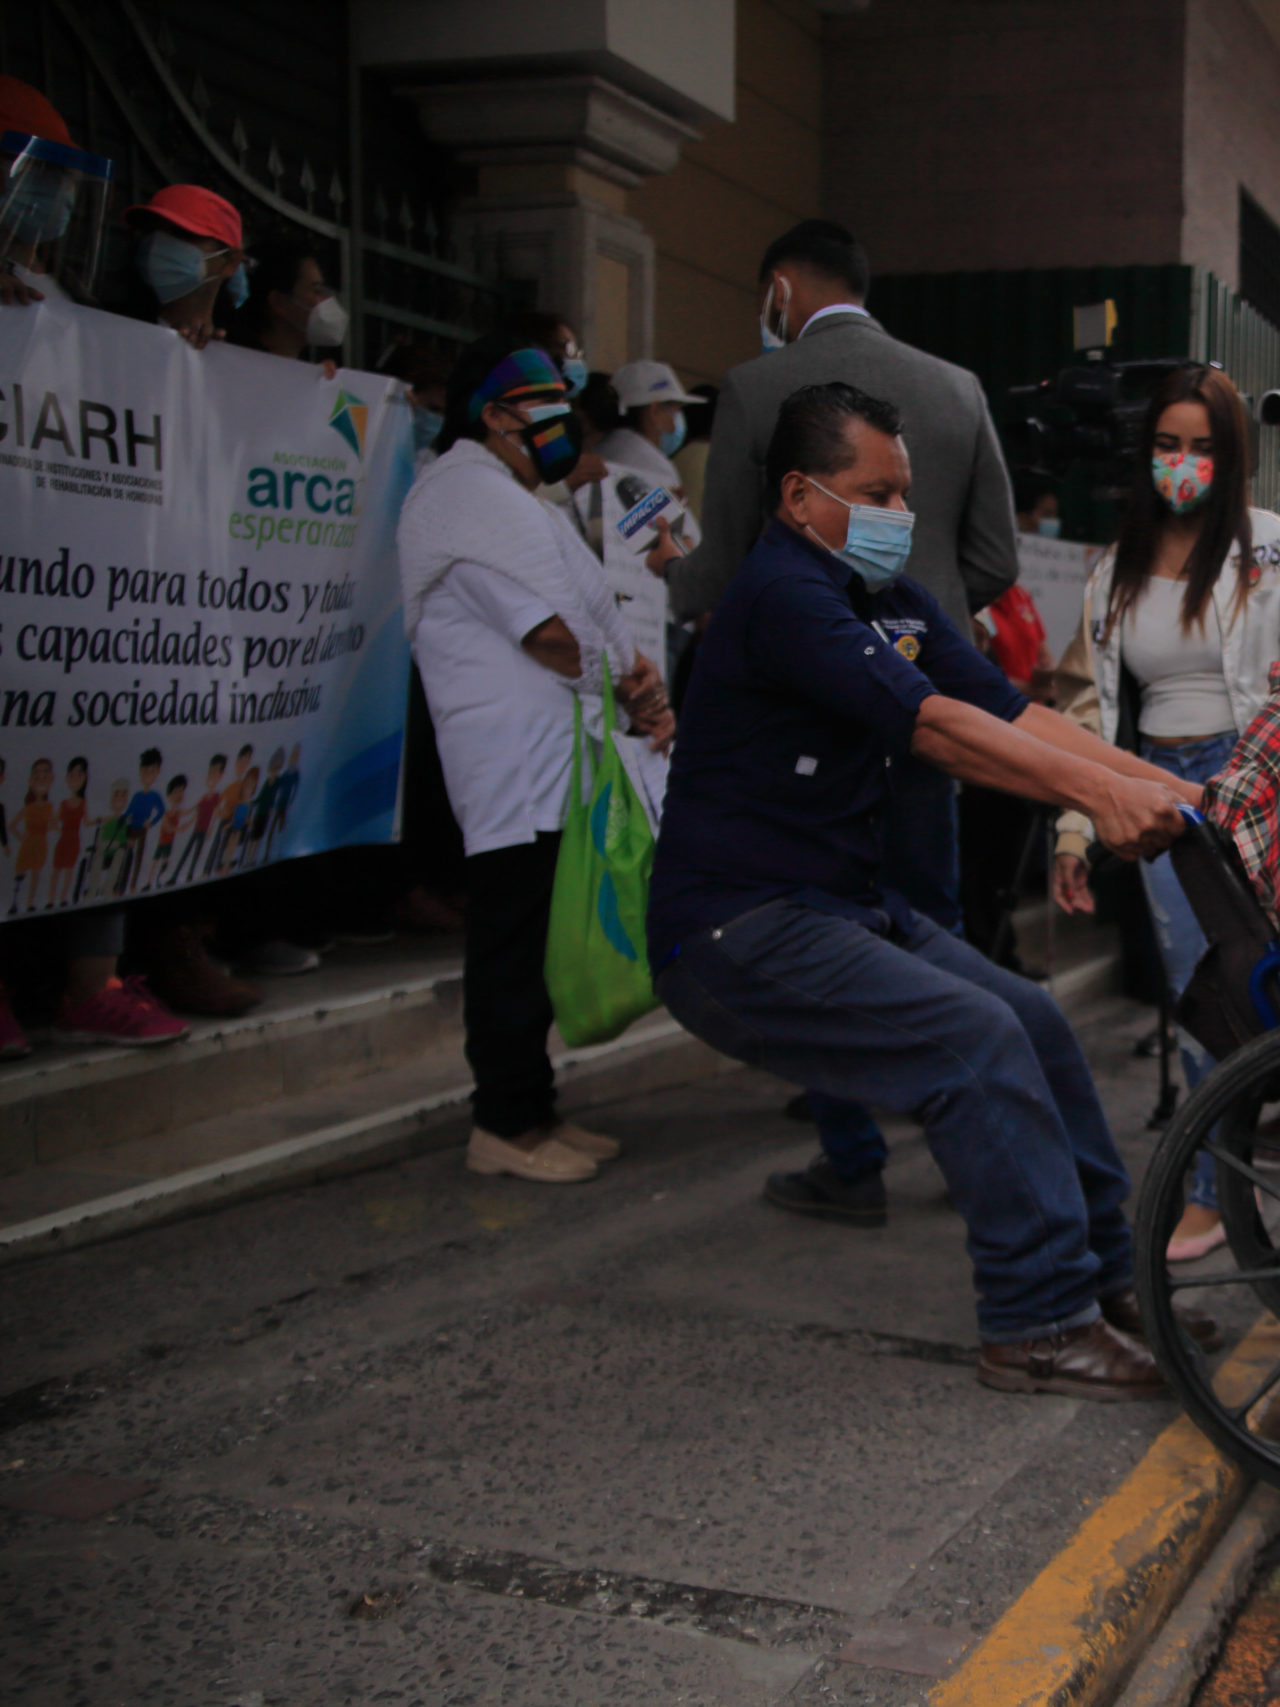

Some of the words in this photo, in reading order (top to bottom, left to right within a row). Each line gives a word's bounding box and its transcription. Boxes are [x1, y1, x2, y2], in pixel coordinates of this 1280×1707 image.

[0, 383, 162, 472] IARH
[247, 466, 354, 517] arca
[107, 566, 186, 612] para
[198, 567, 290, 613] todos
[298, 583, 319, 624] y
[17, 618, 232, 674] capacidades
[243, 634, 303, 677] por
[301, 624, 324, 667] el
[67, 679, 218, 727] sociedad
[229, 677, 323, 725] inclusiva
